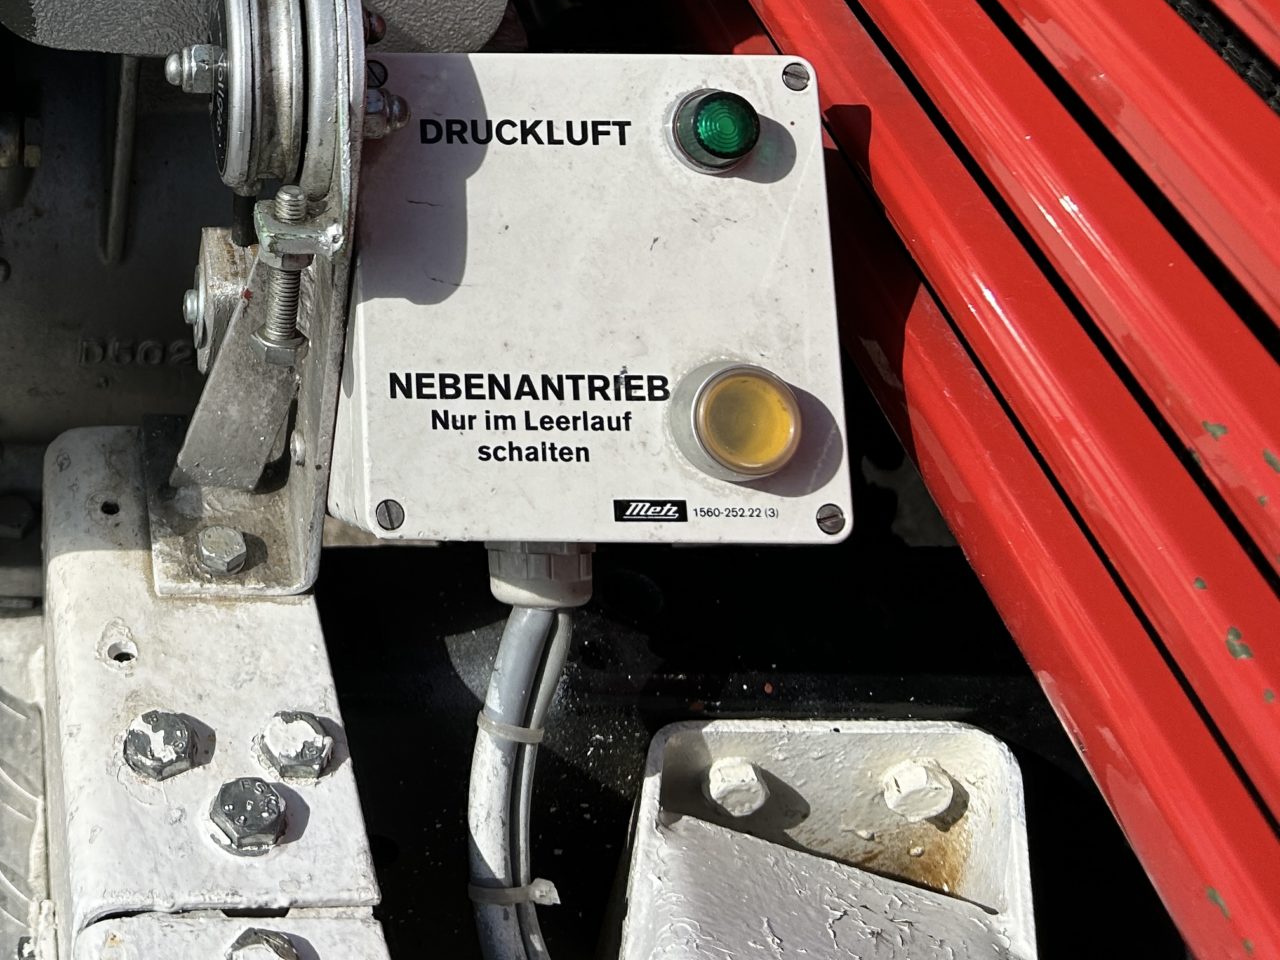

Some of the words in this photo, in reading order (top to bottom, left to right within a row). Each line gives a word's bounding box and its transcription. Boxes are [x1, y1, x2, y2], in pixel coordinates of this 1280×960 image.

[421, 119, 632, 146] DRUCKLUFT
[389, 372, 670, 402] NEBENANTRIEB
[431, 409, 477, 431] Nur
[485, 409, 517, 431] im
[524, 410, 632, 433] Leerlauf
[477, 441, 590, 463] schalten
[623, 501, 680, 519] Metz
[693, 507, 762, 518] 1560-252.22
[764, 507, 779, 519] (3)
